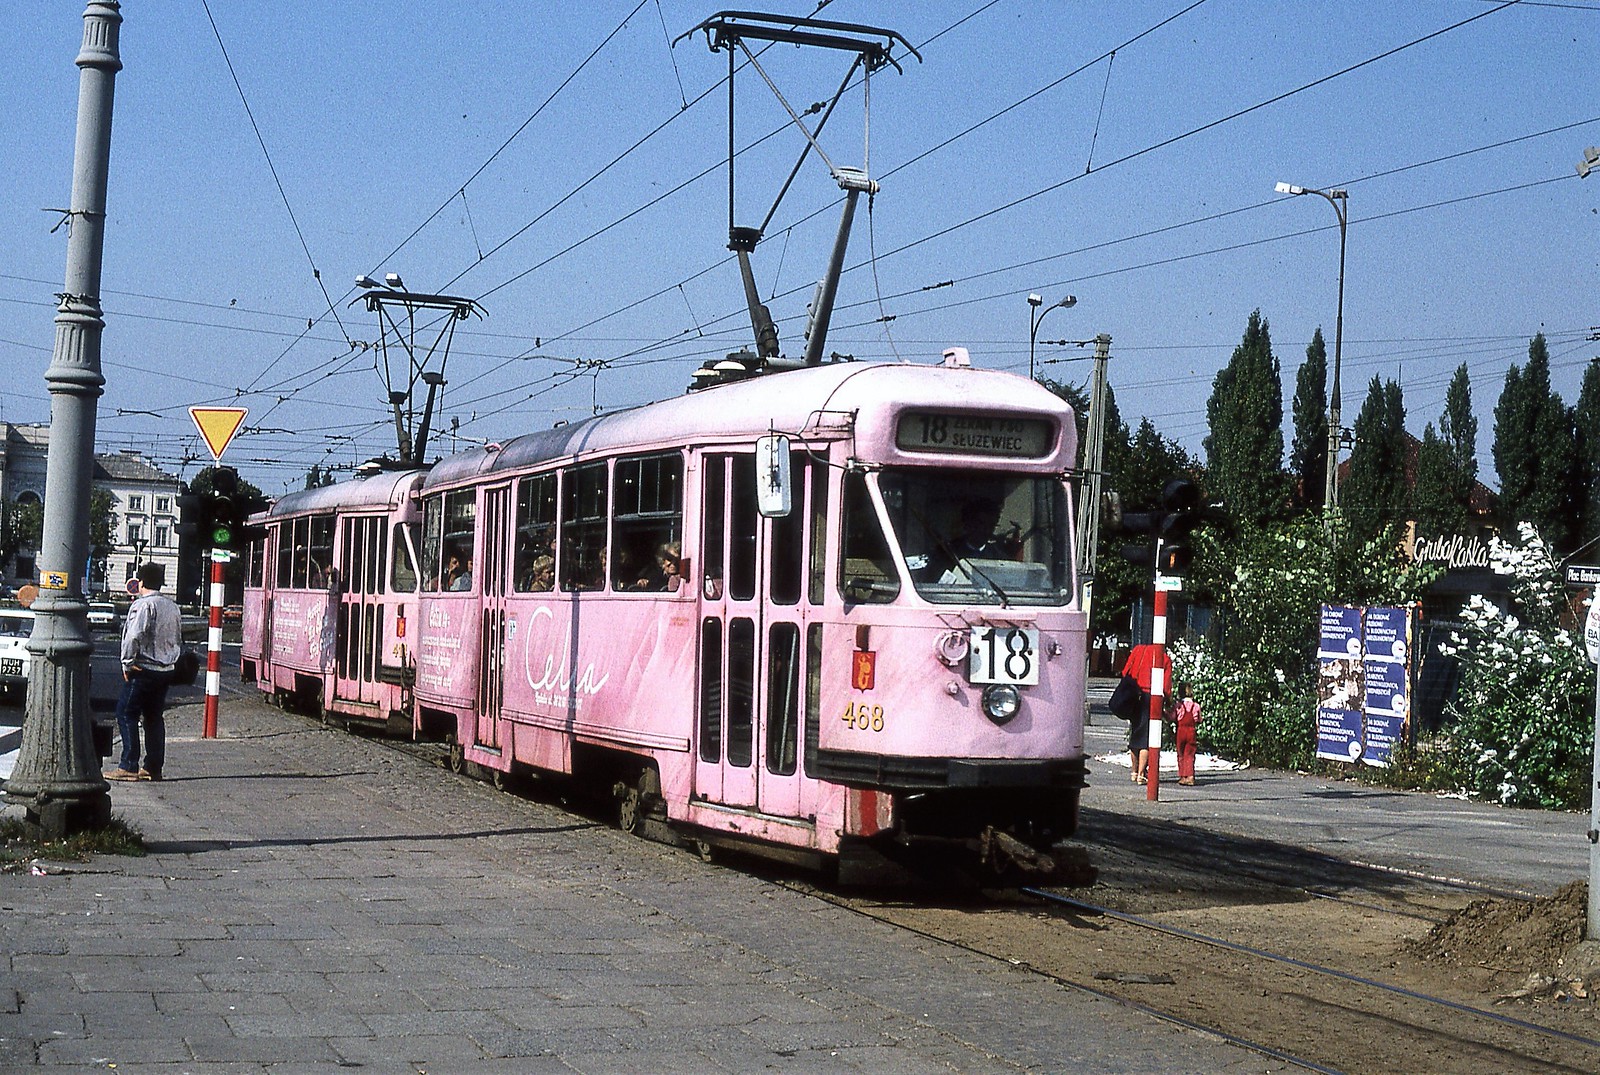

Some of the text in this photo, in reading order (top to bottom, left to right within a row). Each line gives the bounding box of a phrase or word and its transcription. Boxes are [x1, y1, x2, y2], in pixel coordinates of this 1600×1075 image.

[921, 415, 948, 444] 18
[1413, 534, 1452, 568] Gruba
[1567, 568, 1580, 582] Plac
[2, 658, 20, 667] WUH
[980, 629, 1032, 680] 18
[2, 665, 21, 675] 9757
[841, 701, 884, 732] 468
